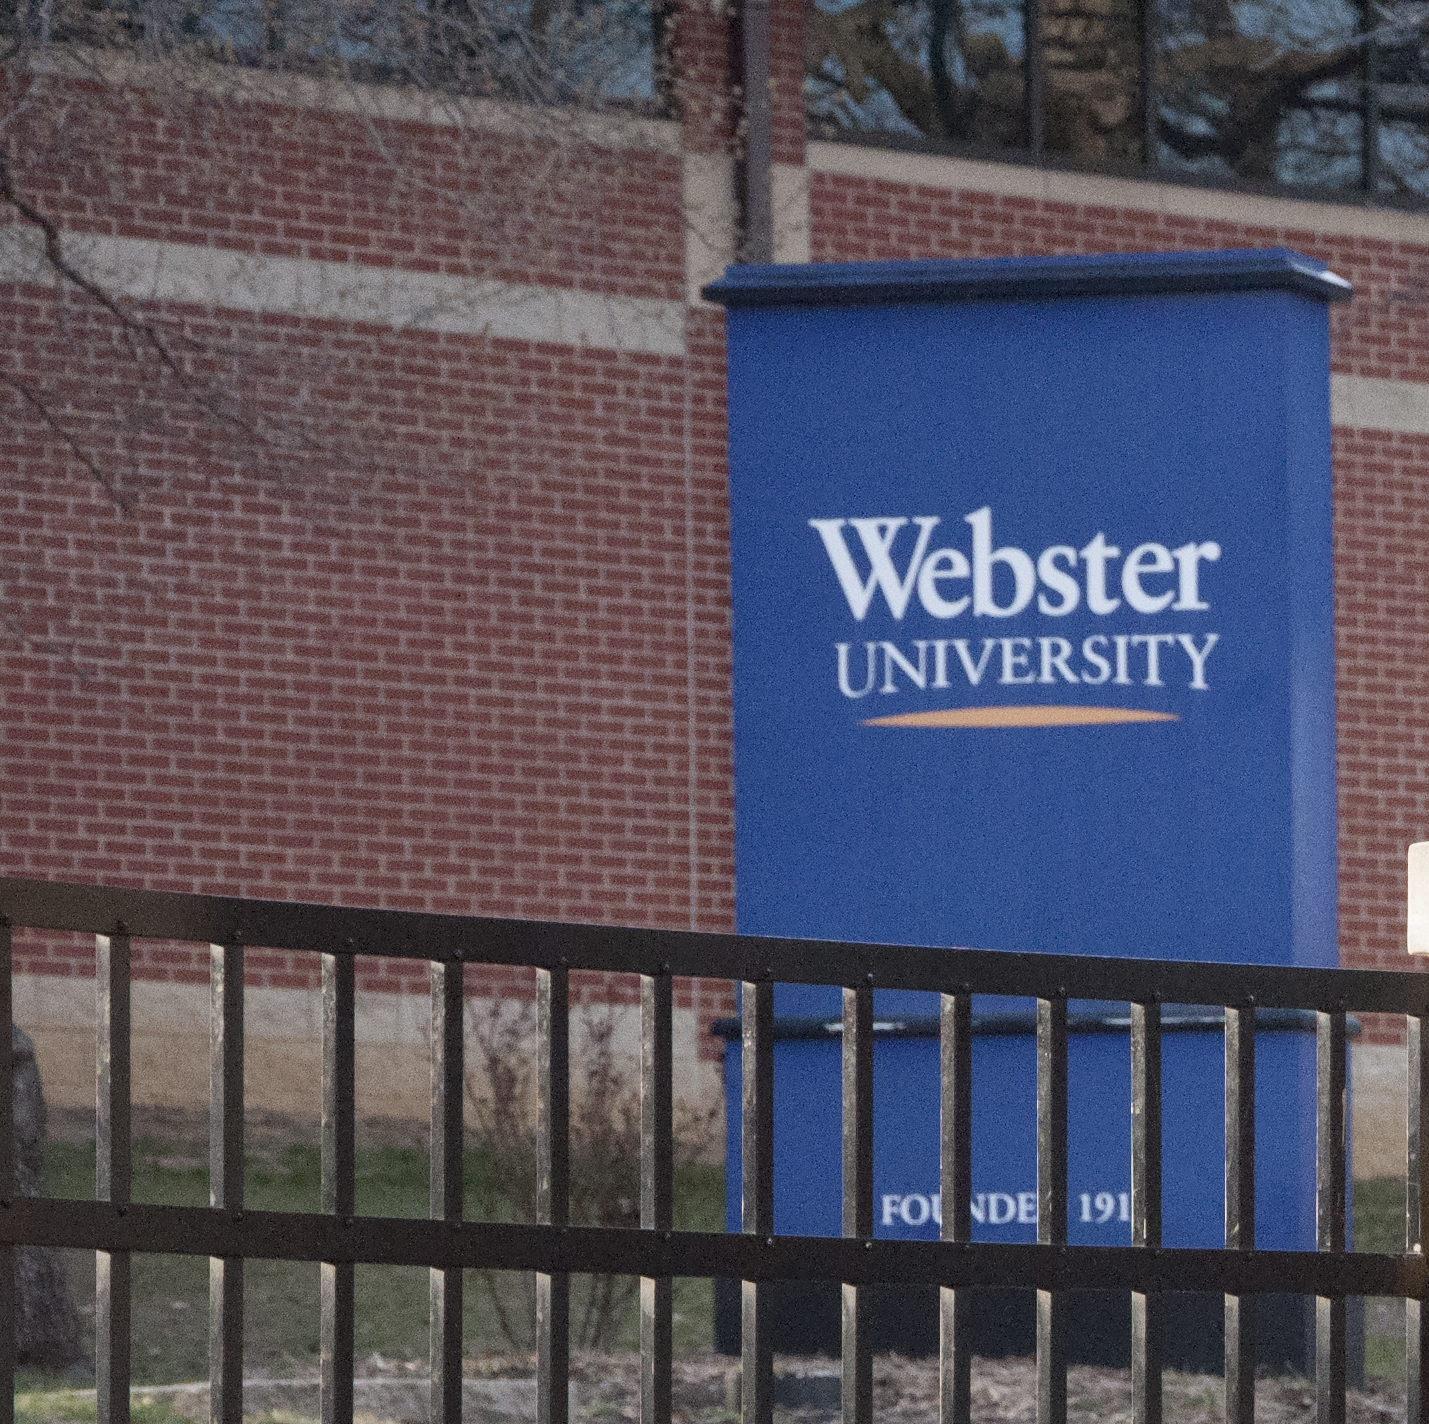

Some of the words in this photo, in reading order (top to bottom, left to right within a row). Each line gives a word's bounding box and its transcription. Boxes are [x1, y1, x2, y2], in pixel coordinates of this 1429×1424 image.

[808, 506, 1221, 621] Webster
[834, 633, 1219, 699] UNIVERSITY
[881, 1192, 1040, 1226] FONDE
[1078, 1191, 1131, 1223] 191
